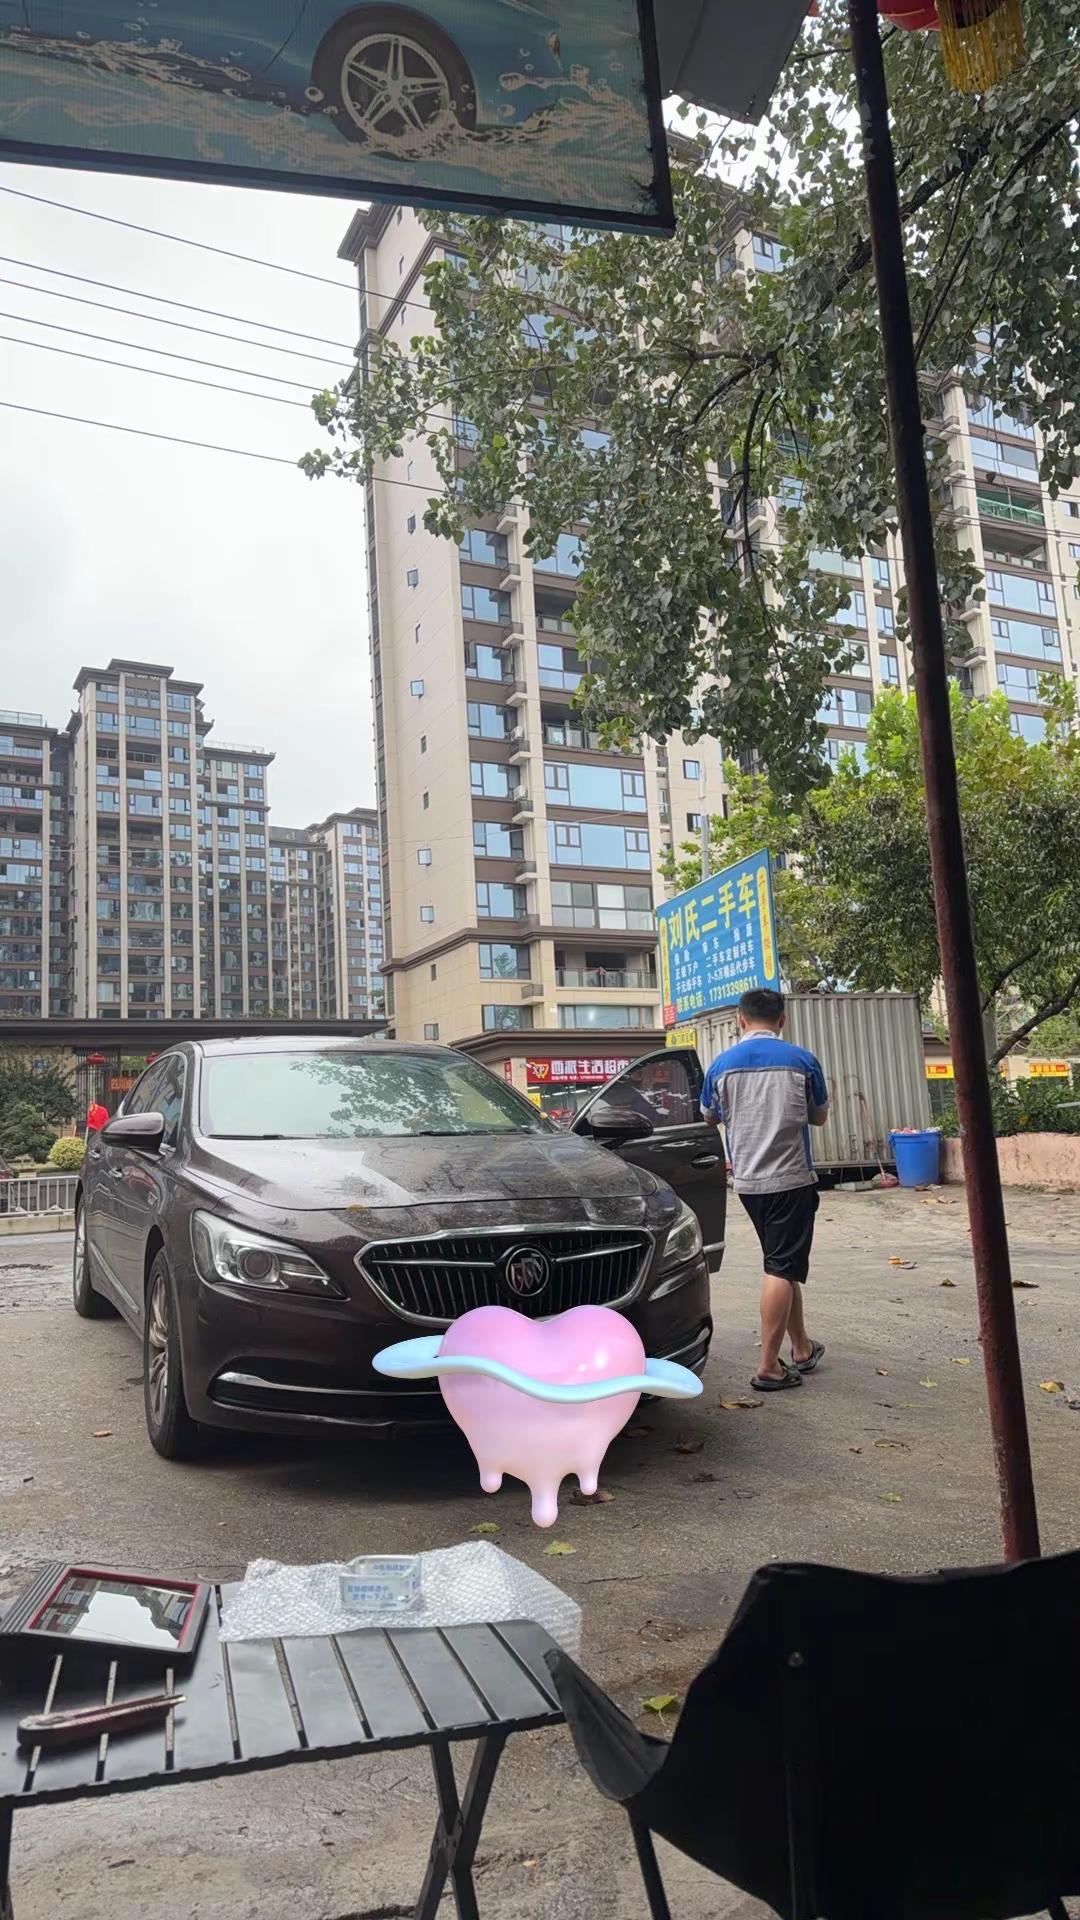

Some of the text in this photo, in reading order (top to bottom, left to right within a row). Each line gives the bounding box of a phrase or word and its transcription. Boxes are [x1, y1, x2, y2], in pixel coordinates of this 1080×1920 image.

[668, 872, 756, 950] 刘氏二手车
[707, 956, 756, 983] 2-5万精品代步车
[551, 1059, 636, 1075] 西派生活超市
